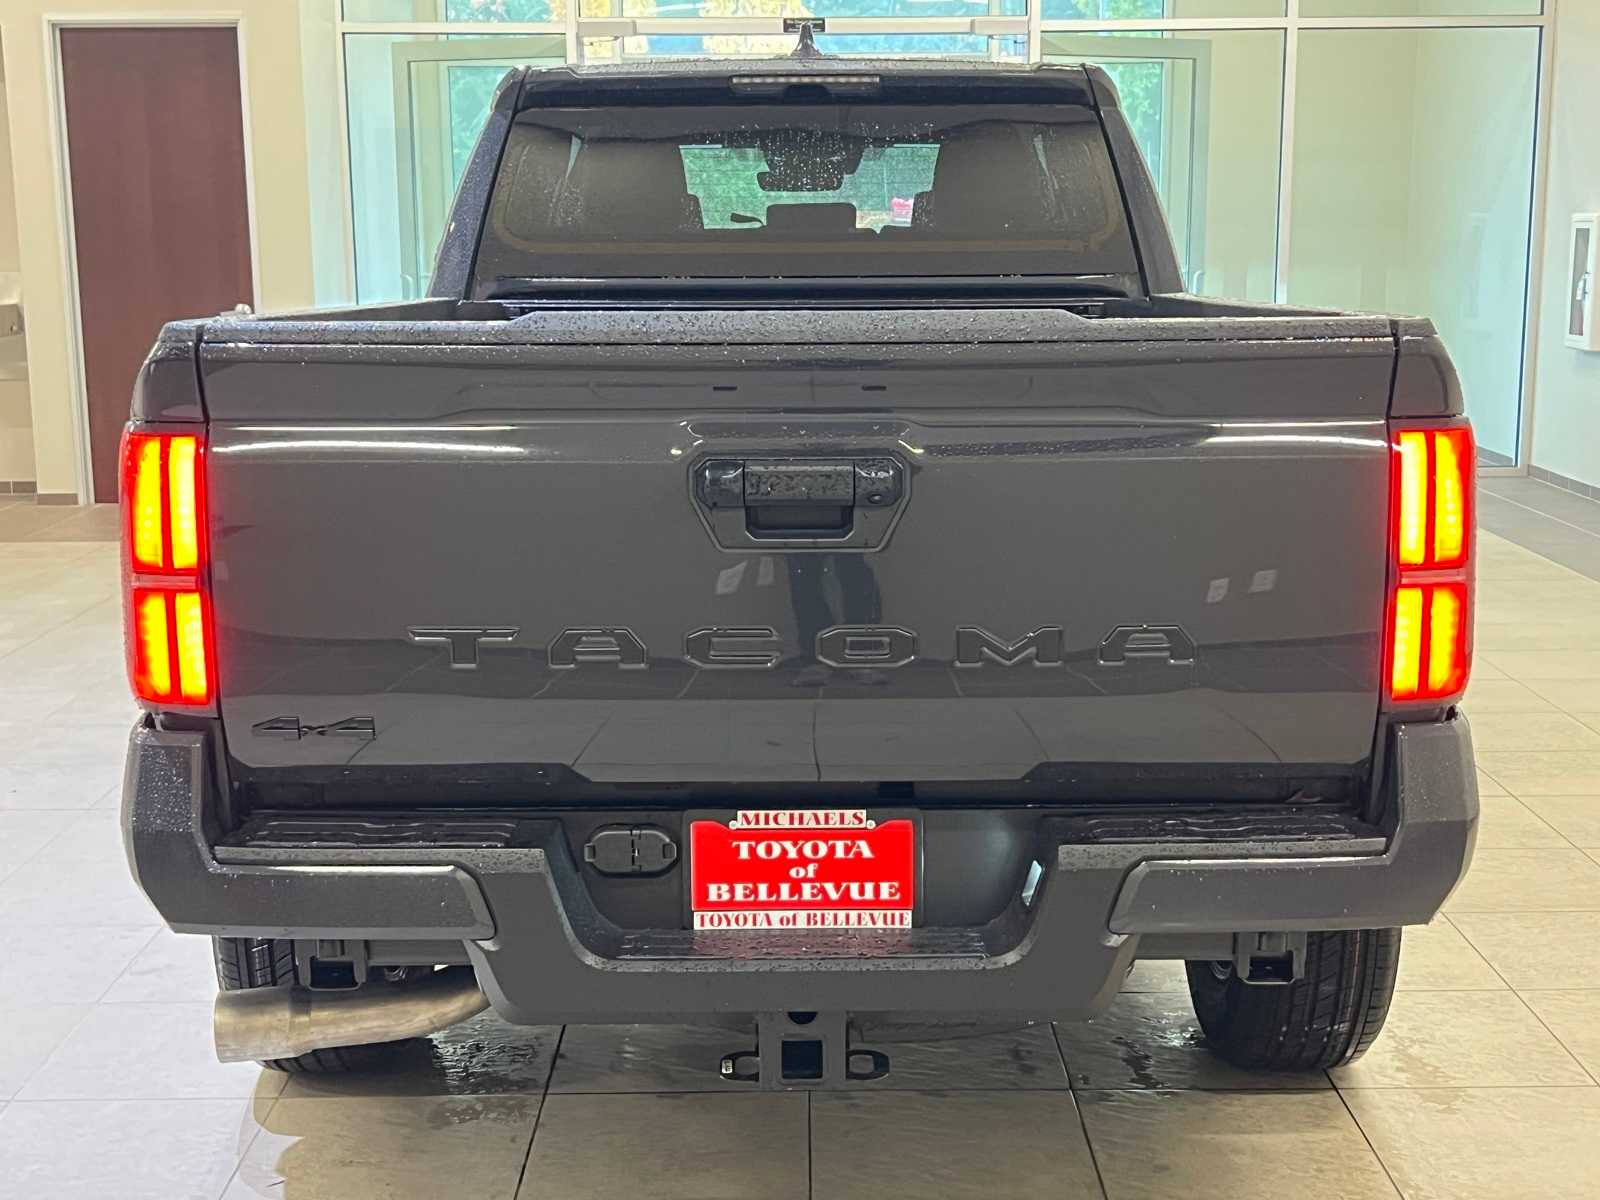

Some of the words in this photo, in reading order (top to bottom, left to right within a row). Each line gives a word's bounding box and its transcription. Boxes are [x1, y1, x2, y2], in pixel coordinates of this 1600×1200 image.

[407, 624, 1197, 670] TACOMA
[740, 811, 864, 827] MICHAELS
[731, 840, 875, 860] TOYOTA
[789, 863, 818, 879] of
[706, 882, 901, 902] BELLEVUE
[696, 914, 773, 928] TOYOTA
[779, 913, 799, 927] of
[806, 912, 911, 927] BELLEVUE
